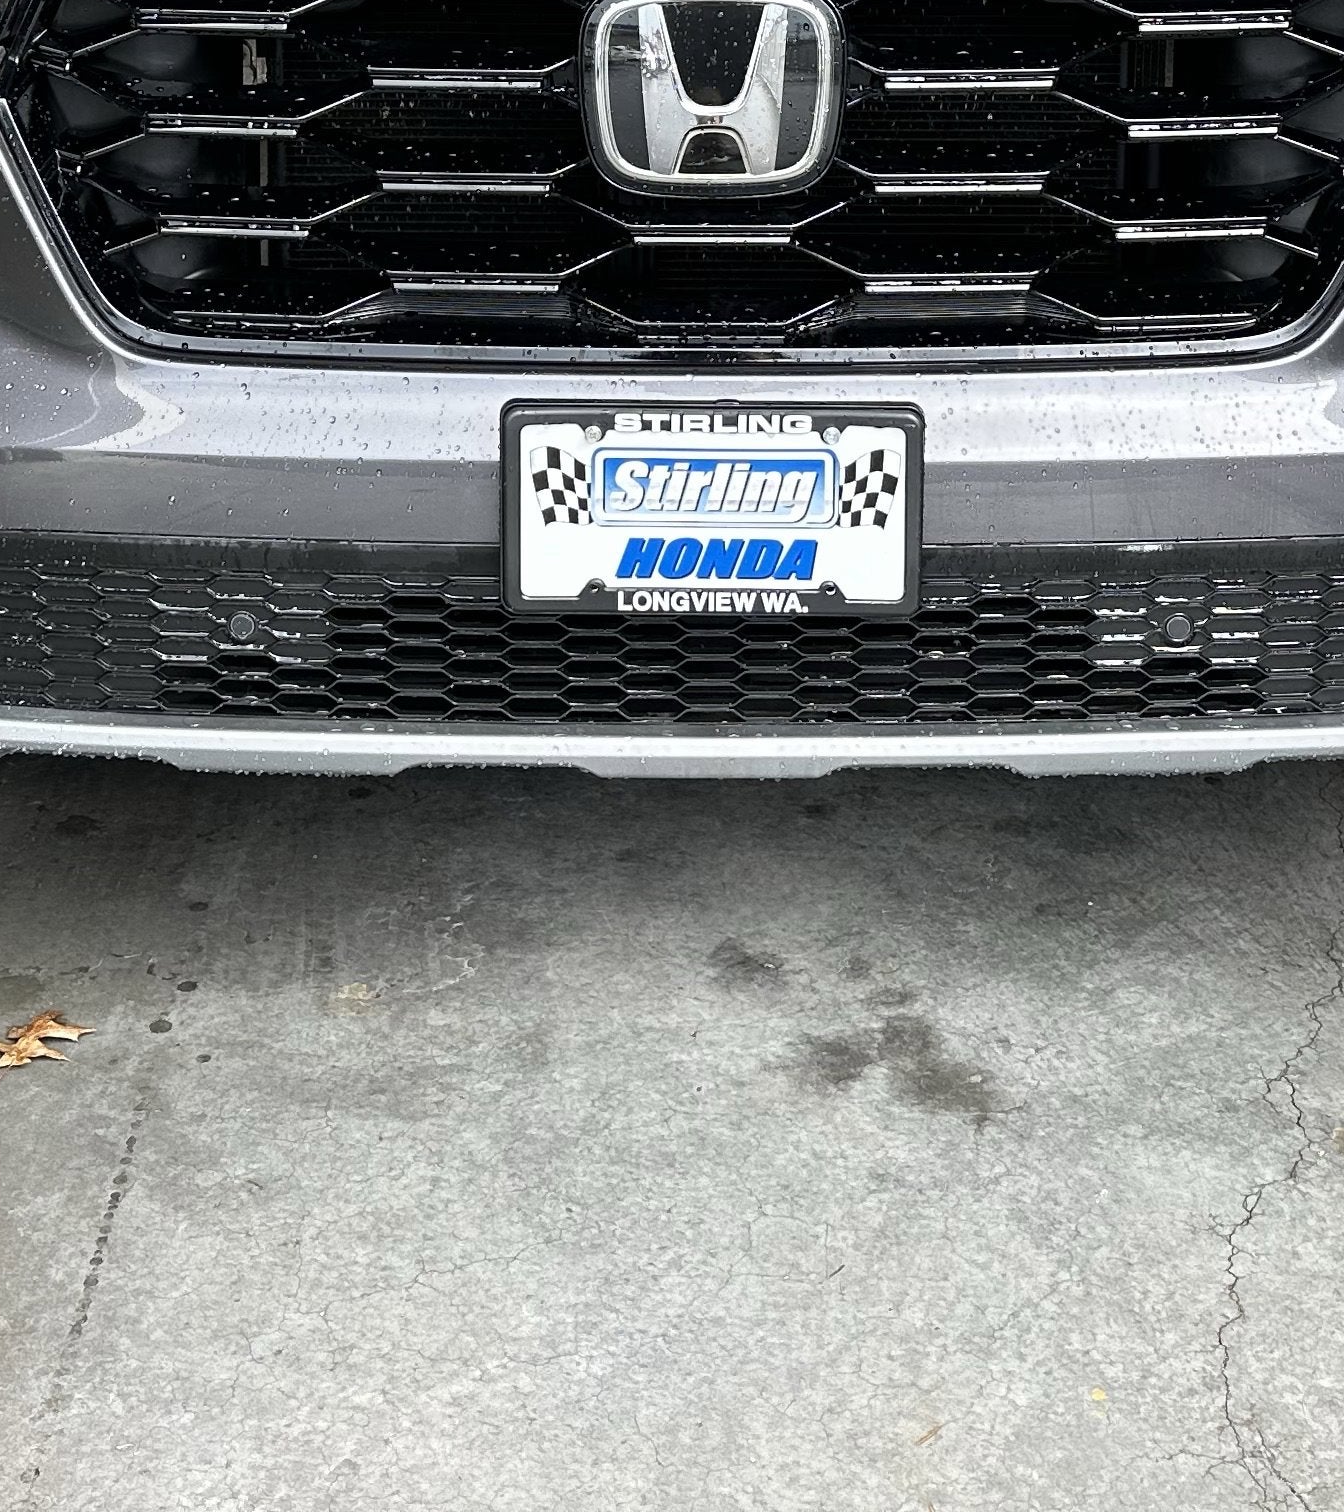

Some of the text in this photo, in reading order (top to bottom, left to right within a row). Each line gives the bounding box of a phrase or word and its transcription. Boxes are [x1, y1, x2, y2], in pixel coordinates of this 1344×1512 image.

[614, 413, 813, 433] STIRLING
[614, 461, 819, 522] Stirling
[616, 537, 818, 580] HONDA
[617, 591, 809, 613] LONGVIEW WA.
